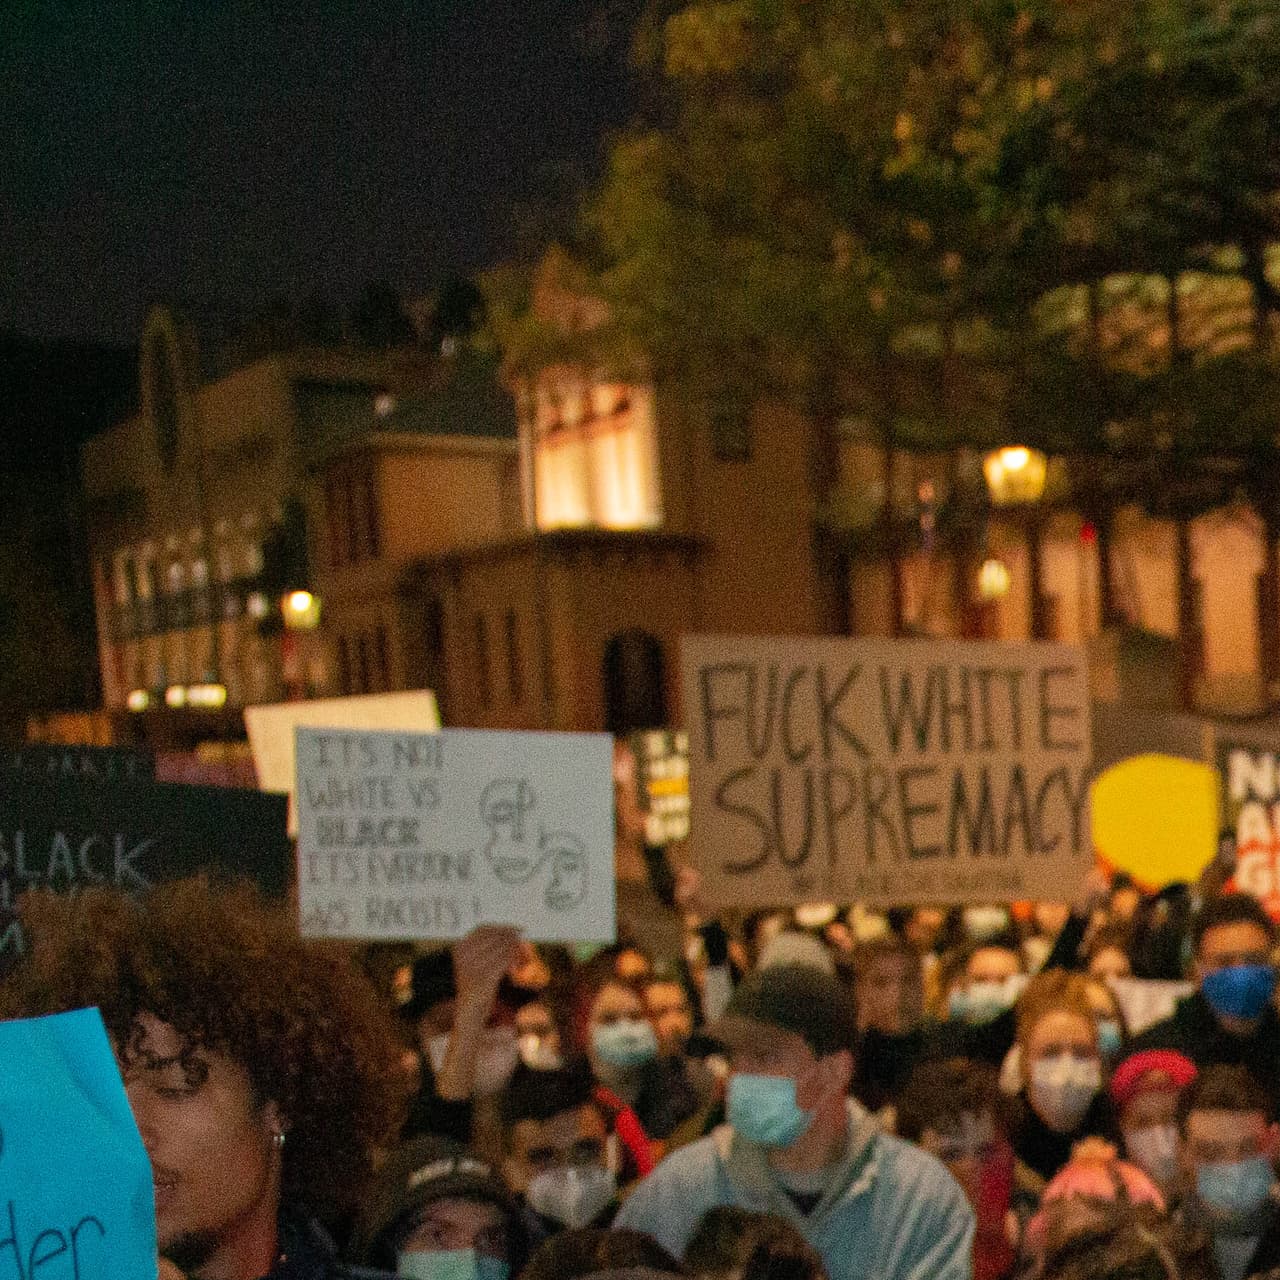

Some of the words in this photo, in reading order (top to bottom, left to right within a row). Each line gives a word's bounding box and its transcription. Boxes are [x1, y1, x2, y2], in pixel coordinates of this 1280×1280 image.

[699, 659, 871, 766] FUCK
[877, 661, 1085, 755] WHITE
[0, 829, 153, 890] LACK
